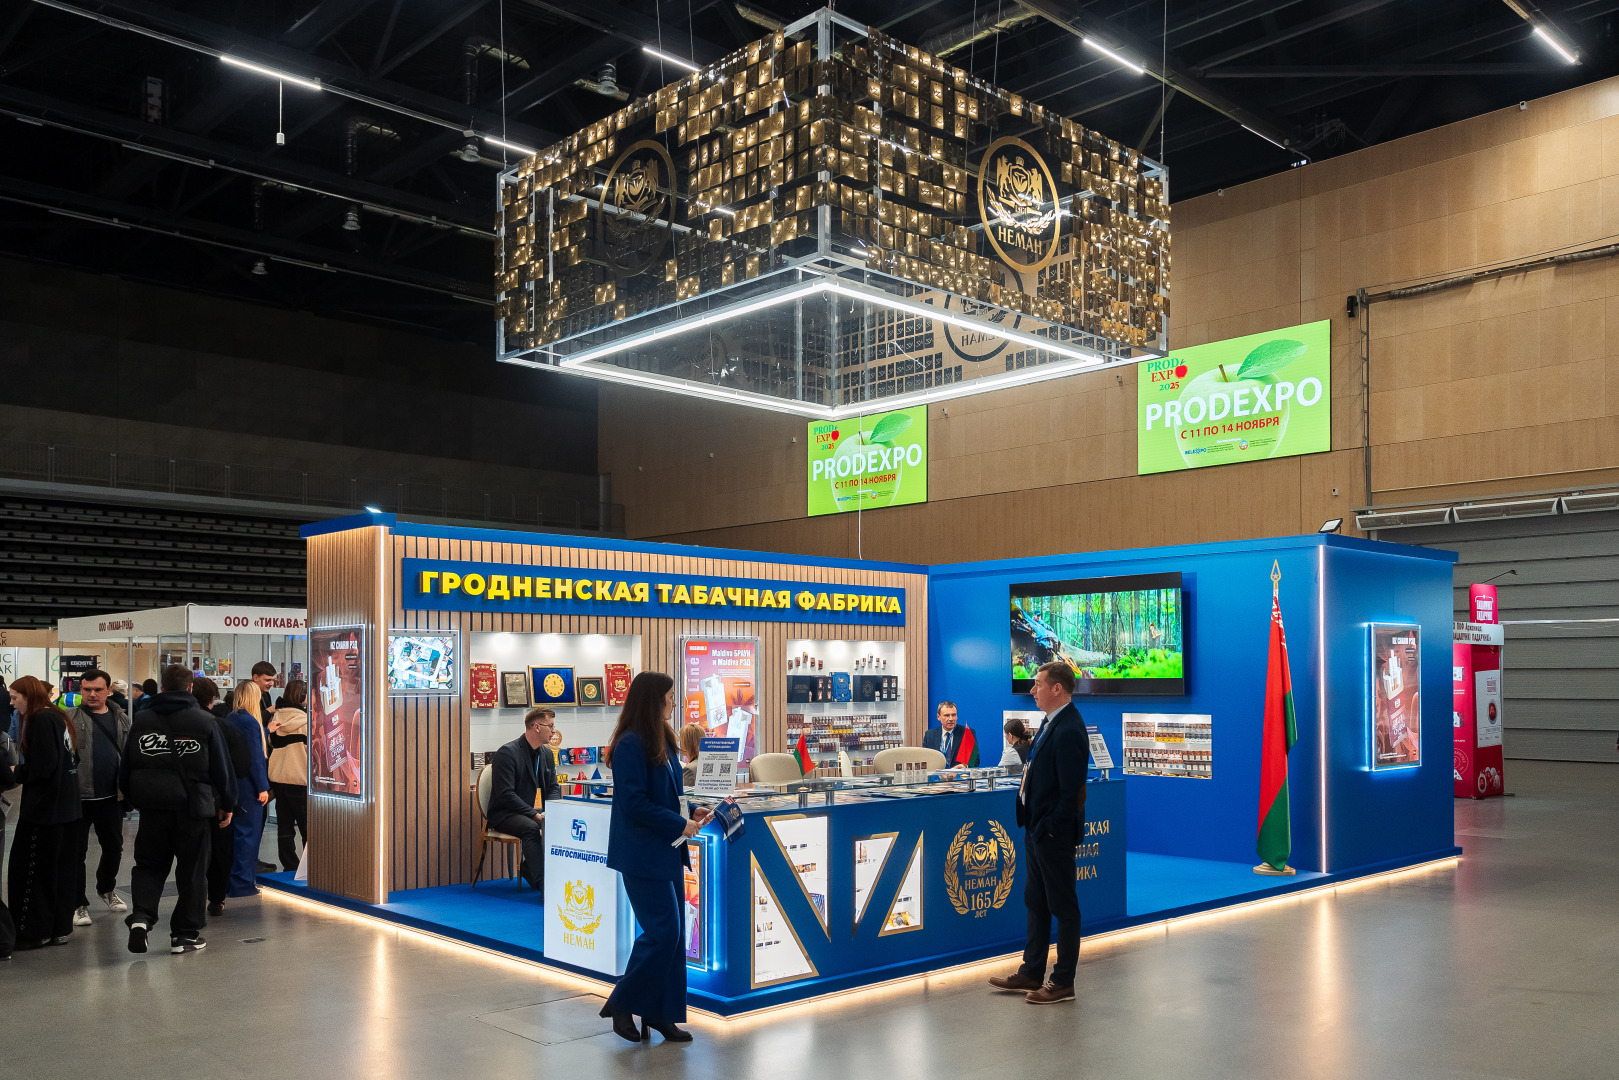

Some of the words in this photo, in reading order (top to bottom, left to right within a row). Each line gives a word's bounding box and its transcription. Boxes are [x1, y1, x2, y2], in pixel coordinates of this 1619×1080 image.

[998, 225, 1042, 254] НЕМАН
[1147, 358, 1180, 372] PROD
[1159, 382, 1180, 391] 2025
[1146, 376, 1322, 430] PRODEXPO
[814, 424, 834, 435] PROD
[1191, 428, 1200, 438] 11
[1204, 426, 1218, 436] ПО
[1222, 424, 1234, 434] 14
[1236, 416, 1280, 432] НОЯБРЯ
[812, 444, 922, 482] PRODEXPO
[869, 474, 896, 484] НОЯБРЯ
[420, 571, 649, 602] ГРОДНЕНСКАЯ
[656, 584, 791, 609] ТАБАЧНАЯ
[798, 590, 902, 614] ФАБРИКА
[224, 616, 249, 627] ООО
[688, 657, 699, 692] Line
[572, 819, 586, 841] БГП
[964, 876, 997, 891] НЕМАН
[970, 892, 991, 910] 165
[974, 910, 987, 918] лет
[564, 932, 594, 950] НЕМАН
